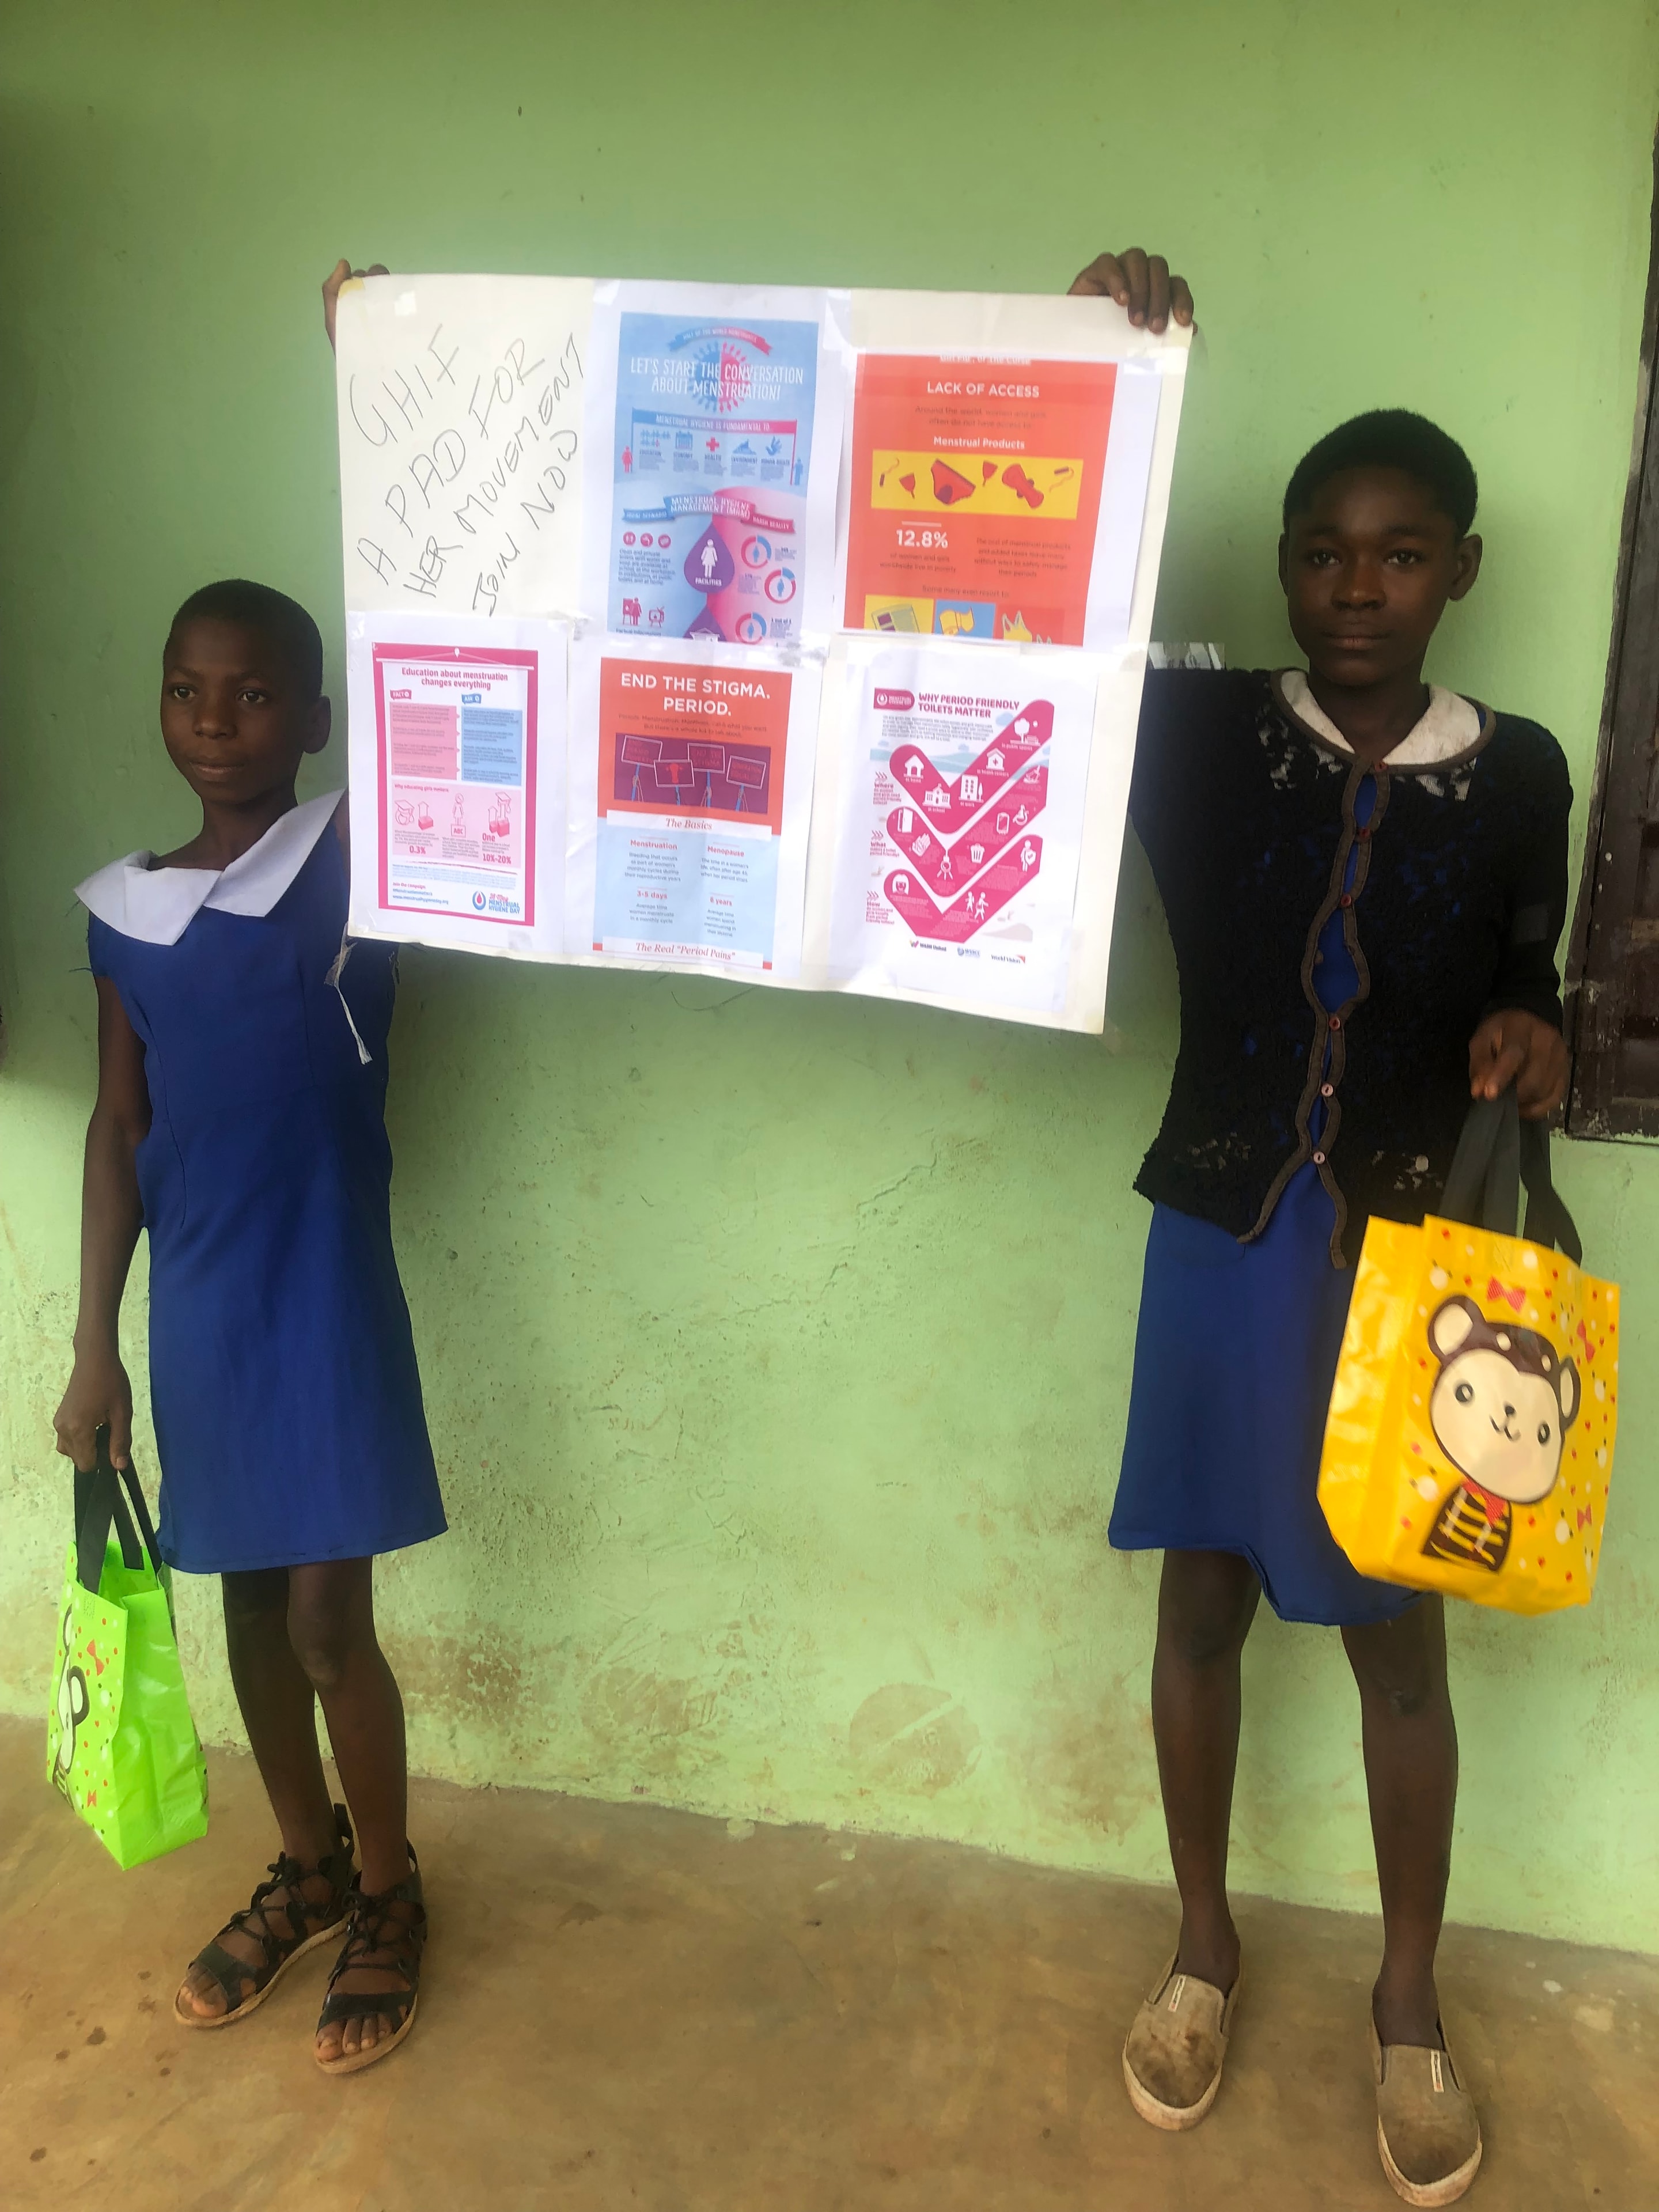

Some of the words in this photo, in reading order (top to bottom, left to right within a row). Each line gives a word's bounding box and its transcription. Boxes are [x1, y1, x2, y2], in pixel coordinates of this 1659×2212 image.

[631, 357, 659, 375] LET'S
[663, 359, 698, 378] START
[701, 361, 719, 379] THE
[724, 363, 804, 384] CONVERSATION
[652, 376, 688, 395] ABOUT
[927, 381, 961, 395] LACK
[966, 382, 985, 395] OF
[988, 384, 1040, 397] ACCESS
[716, 421, 722, 429] IS
[723, 422, 761, 431] FUNDAMENTAL
[933, 435, 980, 447] Menstrual
[983, 438, 1025, 449] Products
[357, 536, 397, 586] A
[385, 429, 467, 538] PAD
[468, 338, 545, 440] FOR
[403, 535, 463, 599] HER
[453, 331, 584, 535] MOVEMENT
[671, 495, 717, 505] MENSTRUAL
[670, 503, 724, 513] MANAGEMENT
[472, 531, 521, 618] JOIN
[521, 430, 578, 531] NOW
[896, 528, 949, 548] 12.8%
[695, 577, 722, 586] FACILITIES
[402, 667, 438, 677] Education
[440, 669, 461, 678] about
[463, 671, 508, 681] menstruation
[421, 677, 452, 688] changes
[453, 680, 491, 691] everything
[621, 672, 657, 689] END
[662, 675, 696, 692] THE
[702, 679, 771, 699] STIGMA.
[663, 696, 732, 717] PERIOD.
[919, 692, 940, 703] WHY
[940, 694, 974, 706] PERIOD
[975, 698, 1020, 710] FRIENDLY
[918, 702, 953, 715] TOILETS
[955, 706, 992, 718] MATTER
[666, 818, 682, 828] The
[684, 820, 713, 830] Basics
[482, 833, 495, 842] One
[410, 845, 426, 855] 0.3%
[630, 839, 677, 850] Menstruation
[707, 845, 744, 857] Menopause
[483, 853, 512, 864] 10%-20%
[651, 891, 668, 900] days
[715, 898, 733, 907] years
[510, 906, 520, 914] DAY
[637, 942, 652, 952] The
[654, 944, 675, 954] Real
[991, 954, 1006, 963] World
